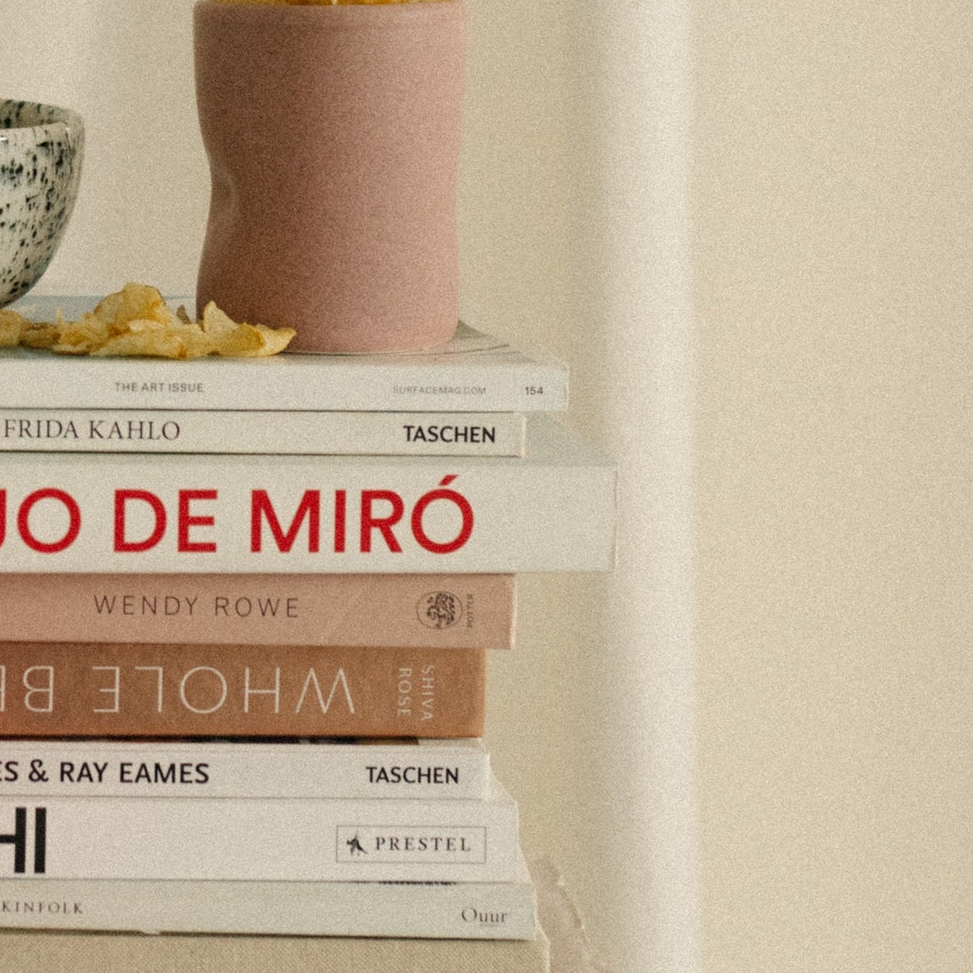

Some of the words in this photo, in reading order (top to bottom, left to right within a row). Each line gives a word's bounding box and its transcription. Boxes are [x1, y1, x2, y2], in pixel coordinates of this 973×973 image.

[115, 381, 138, 393] THE
[140, 382, 164, 392] ART
[167, 382, 203, 393] ISSUE
[524, 385, 544, 396] 154
[4, 418, 79, 439] FRIDA
[88, 419, 181, 440] KAHLO
[403, 425, 496, 444] TASCHEN
[113, 488, 218, 553] DE
[250, 474, 475, 555] MIRÓ
[93, 594, 198, 616] WENDY
[214, 595, 299, 619] ROWE
[93, 665, 356, 715] WHOLE
[397, 667, 413, 715] ROSE
[420, 665, 434, 721] SHIVA
[28, 758, 49, 783] &
[59, 761, 108, 783] RAY
[119, 762, 209, 785] EAMES
[366, 766, 459, 784] TASCHEN
[375, 836, 472, 852] PRESTEL
[1, 900, 84, 915] KINFOLK
